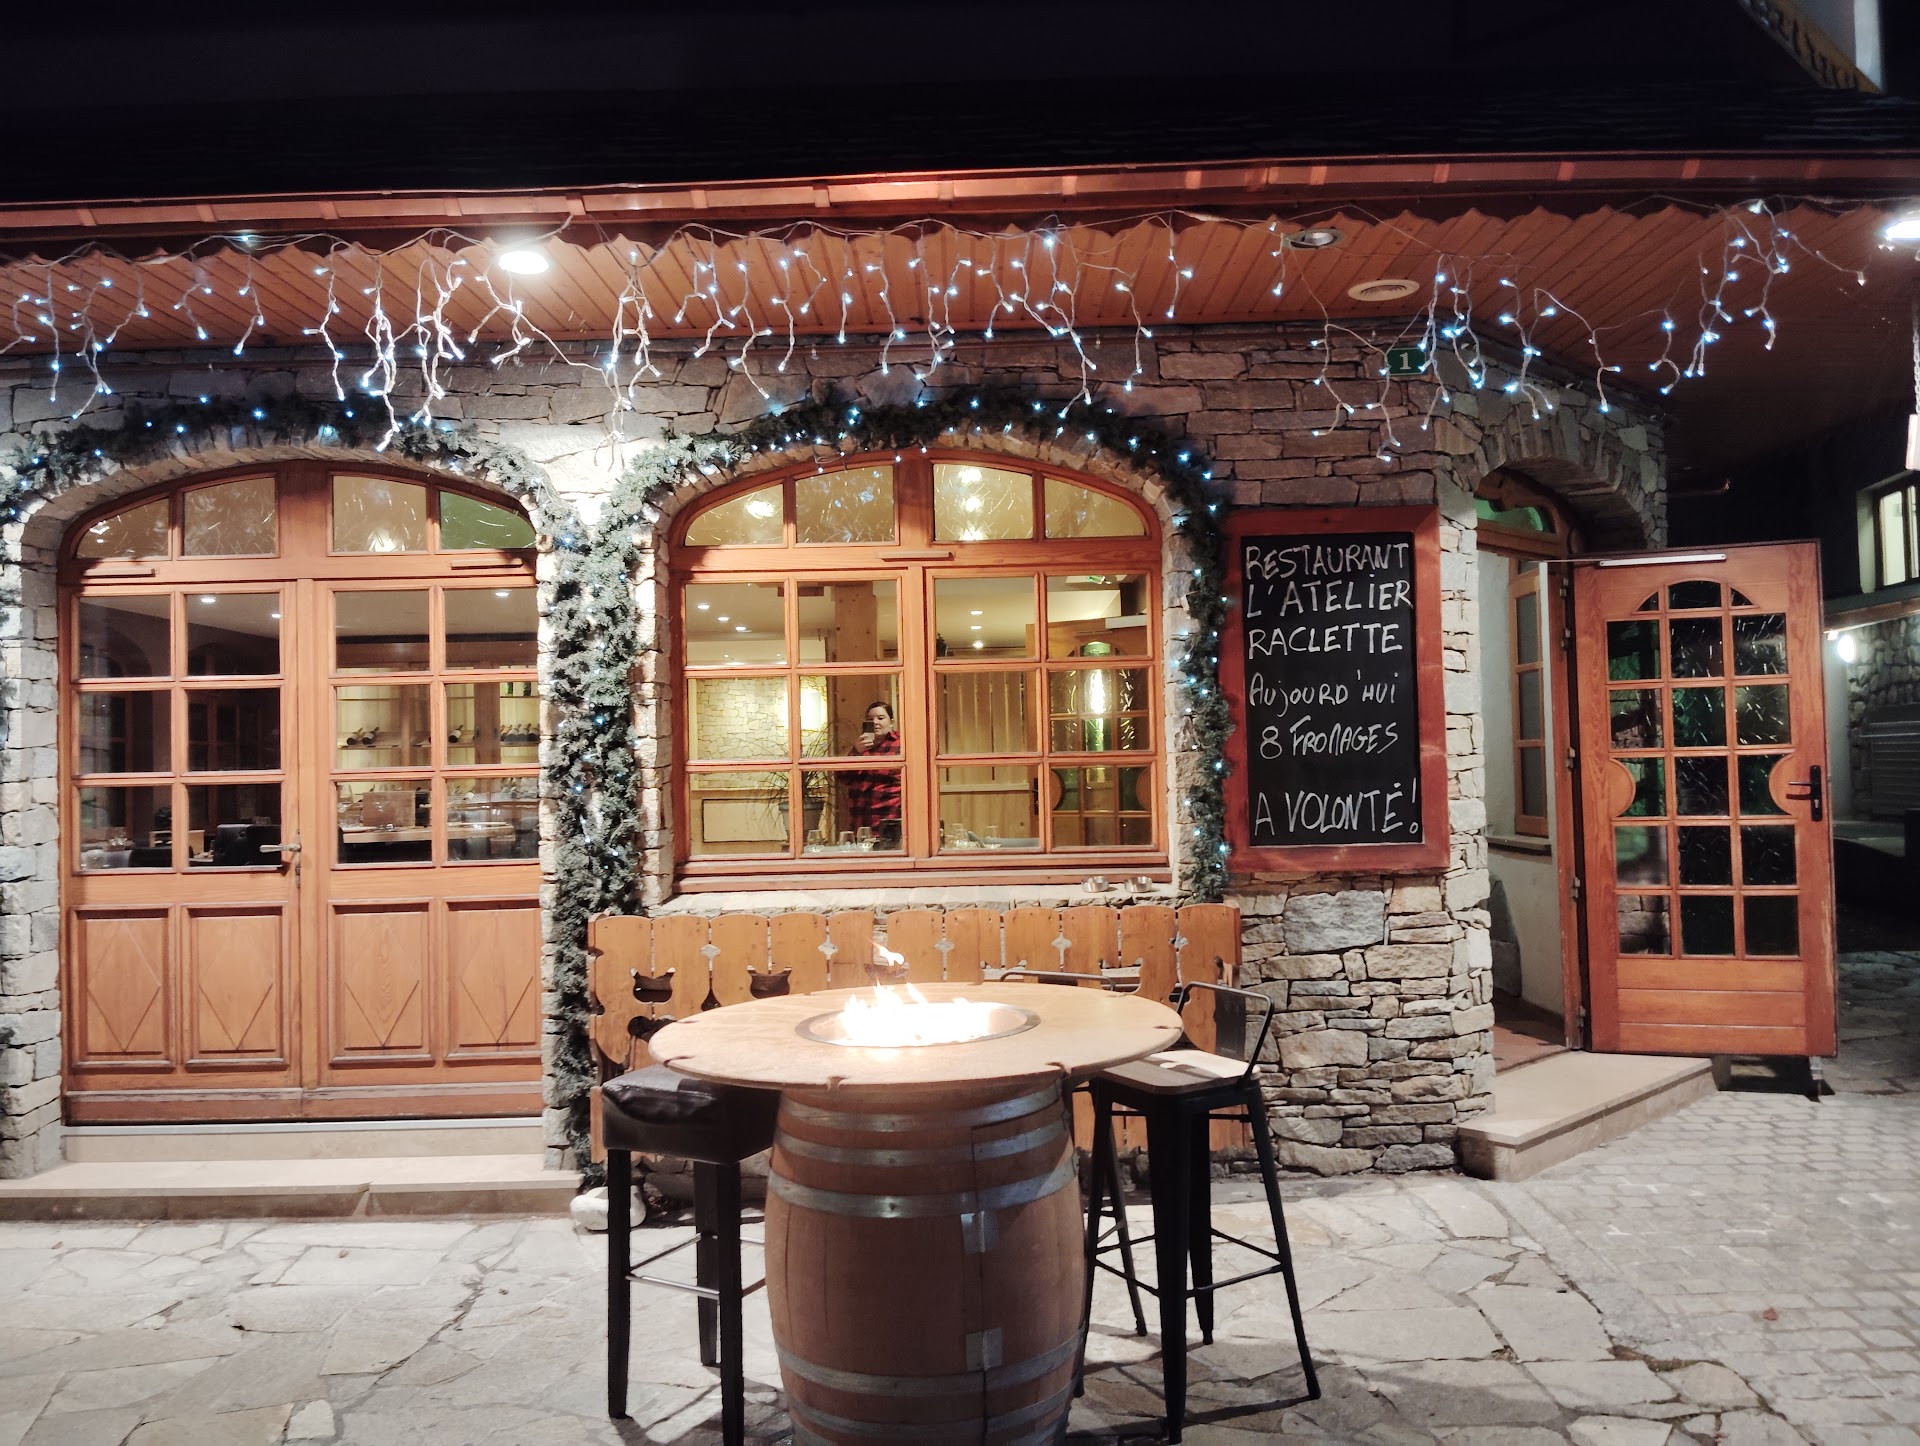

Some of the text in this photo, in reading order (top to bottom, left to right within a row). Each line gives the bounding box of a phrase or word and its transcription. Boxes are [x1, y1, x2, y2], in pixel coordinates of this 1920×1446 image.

[1400, 352, 1411, 370] 1
[1246, 543, 1409, 580] RESTAURANT
[1249, 623, 1402, 660] RACLETTE
[1260, 725, 1282, 760] 8
[1254, 791, 1276, 837] A
